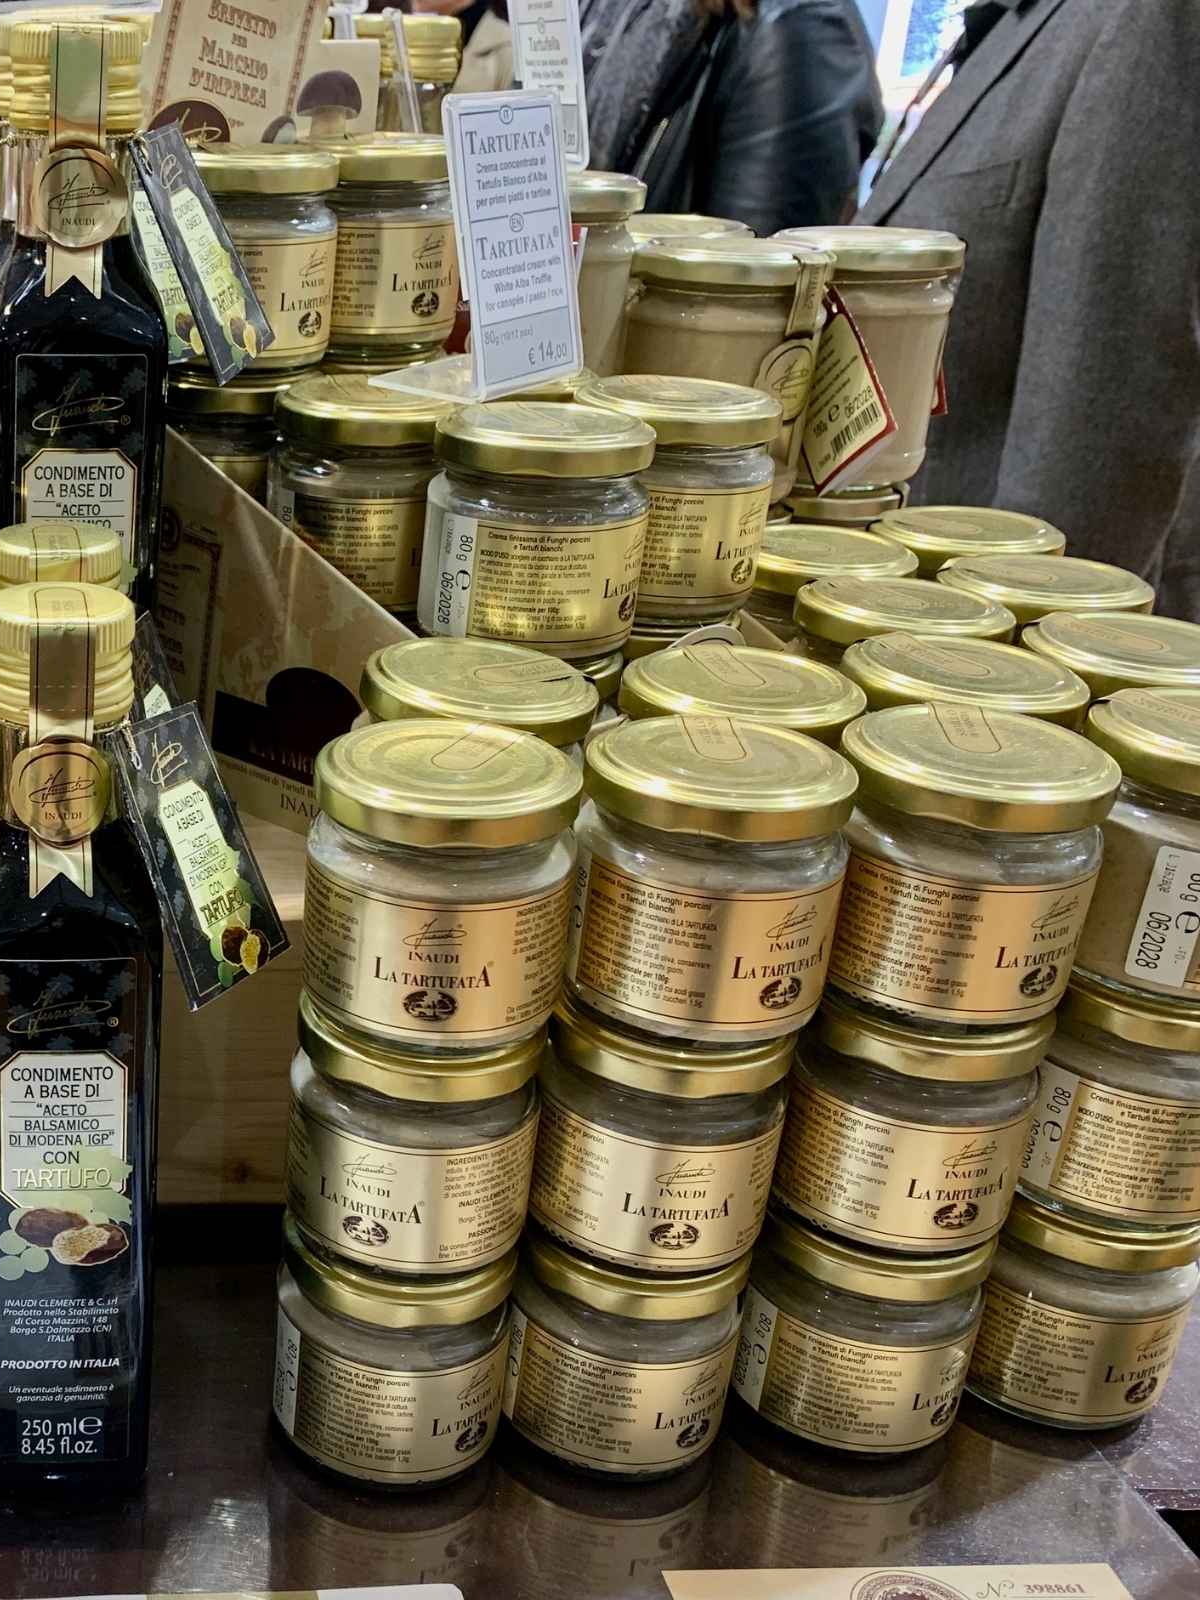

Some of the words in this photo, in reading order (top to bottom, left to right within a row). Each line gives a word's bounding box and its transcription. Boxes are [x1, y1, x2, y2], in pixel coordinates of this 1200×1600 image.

[34, 466, 125, 481] CONDIMENTO
[45, 484, 55, 497] A
[59, 484, 96, 497] BASE
[99, 483, 112, 497] DI
[1136, 912, 1172, 969] 06/2028
[408, 951, 460, 964] INAUDI
[10, 1066, 114, 1082] CONDIMENTO
[24, 1085, 34, 1098] A
[40, 1084, 79, 1098] BASE
[85, 1084, 99, 1097] DI
[24, 1119, 100, 1131] BALSAMICO
[9, 1135, 21, 1146] DI
[27, 1134, 82, 1146] MODENA
[43, 1151, 80, 1164] CON
[12, 1168, 111, 1188] TARTUFO
[346, 1178, 390, 1198] INAUDI
[659, 1188, 706, 1198] INAUDI
[4, 1299, 36, 1307] INAUDI
[38, 1299, 86, 1307] CLEMENTE
[3, 1308, 42, 1316] Prodotto
[44, 1308, 66, 1316] nello
[14, 1317, 23, 1325] di
[10, 1326, 36, 1335] Borgo
[0, 1360, 67, 1369] PRODOTTO
[69, 1360, 82, 1368] IN
[84, 1358, 120, 1368] ITALIA
[22, 1419, 51, 1436] 250
[57, 1418, 77, 1435] ml
[21, 1439, 55, 1455] 8.45
[60, 1437, 97, 1453] fl.oz.
[1024, 1584, 1086, 1593] 398861
